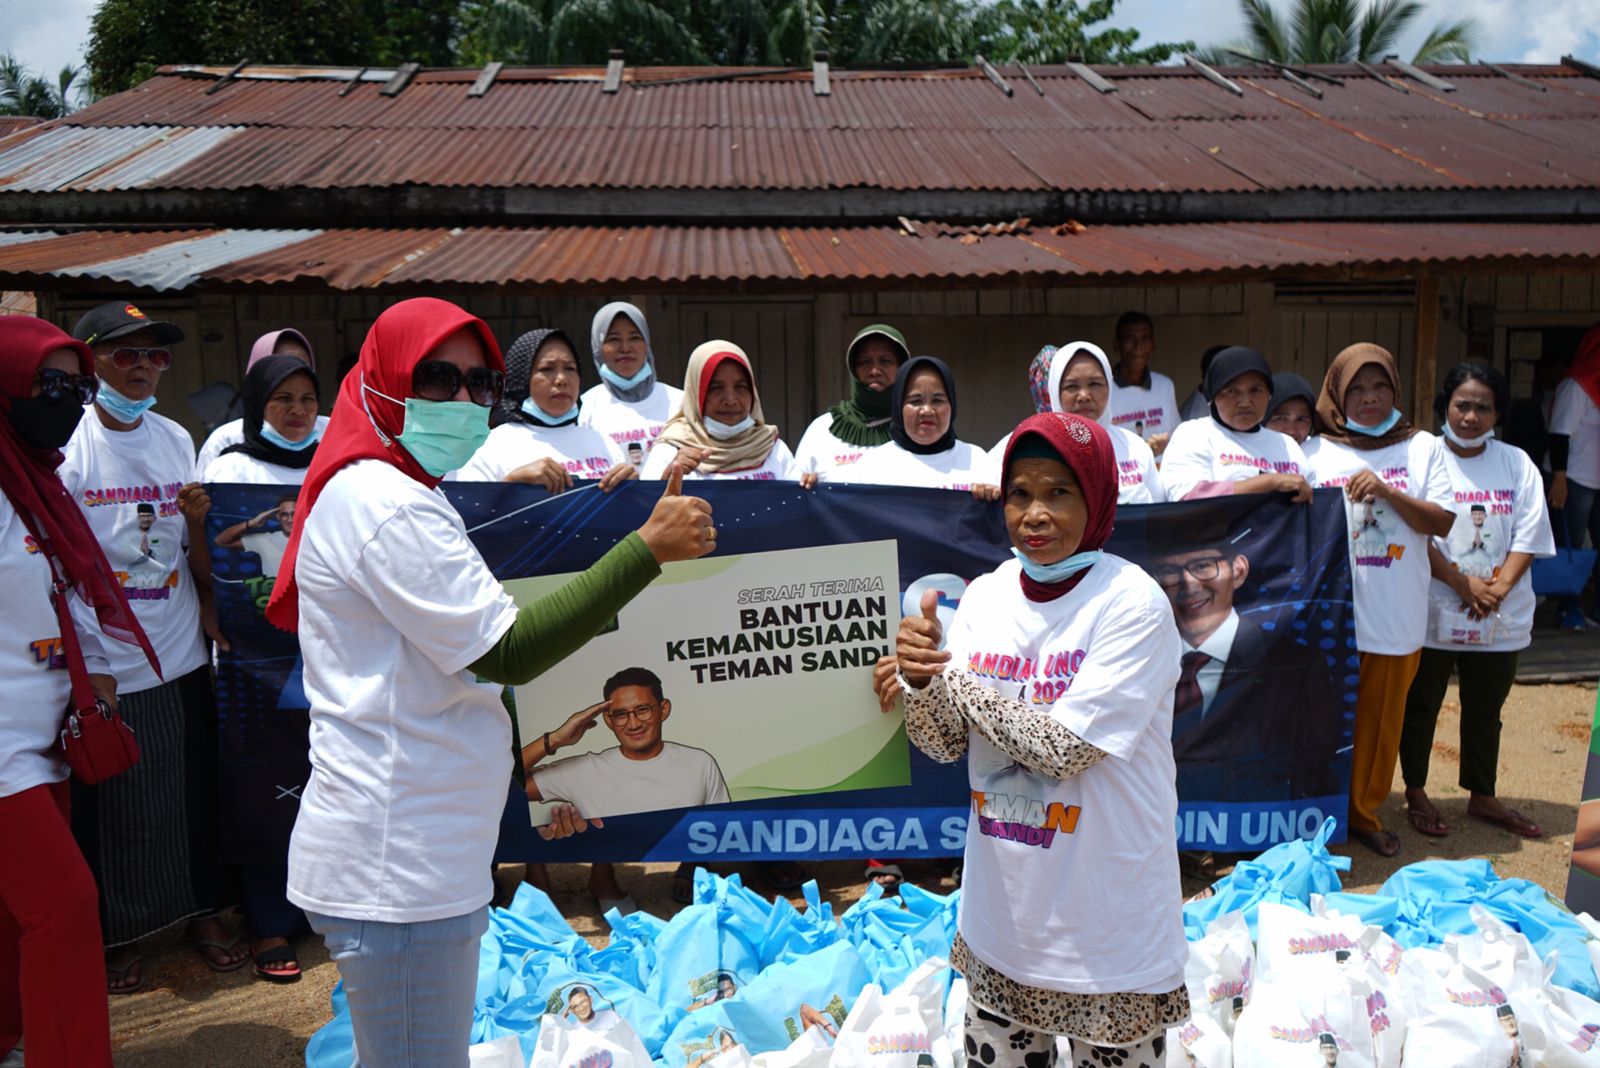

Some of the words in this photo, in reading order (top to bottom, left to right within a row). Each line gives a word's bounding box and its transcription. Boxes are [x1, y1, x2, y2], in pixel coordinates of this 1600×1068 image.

[84, 484, 163, 507] SANDIAGA
[737, 583, 805, 605] SERAH
[810, 576, 884, 598] TERIMA
[739, 596, 886, 630] BANTUAN
[666, 619, 888, 662] KEMANUSIAAN
[690, 654, 793, 684] TEMAN
[1043, 649, 1087, 678] UNO
[970, 790, 1082, 834] TEMAN
[1240, 806, 1325, 845] UNO
[687, 817, 929, 853] SANDIAGA
[978, 815, 1056, 849] SANDI
